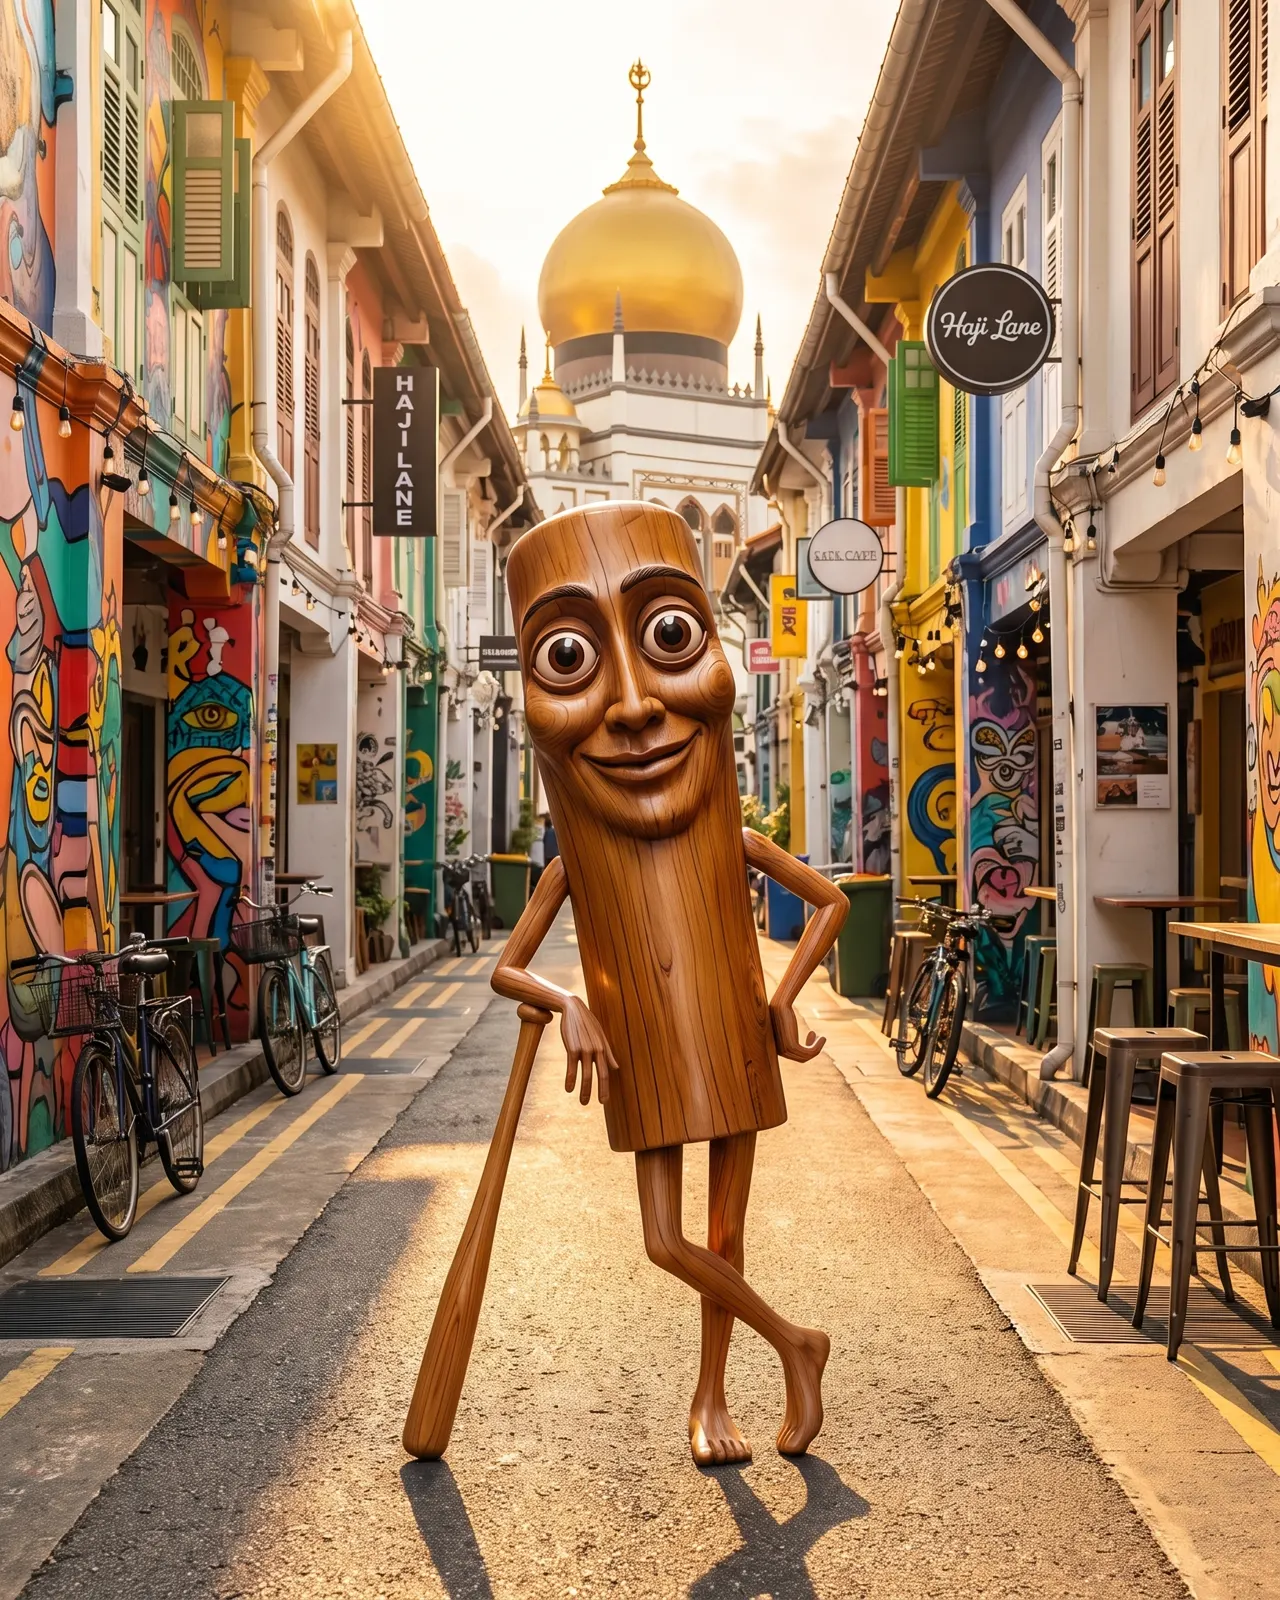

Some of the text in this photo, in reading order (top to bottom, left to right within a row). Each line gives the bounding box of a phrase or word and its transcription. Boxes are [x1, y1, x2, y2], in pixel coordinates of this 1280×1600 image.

[940, 310, 1043, 346] Haji Lane
[394, 375, 414, 526] HAJI LANE
